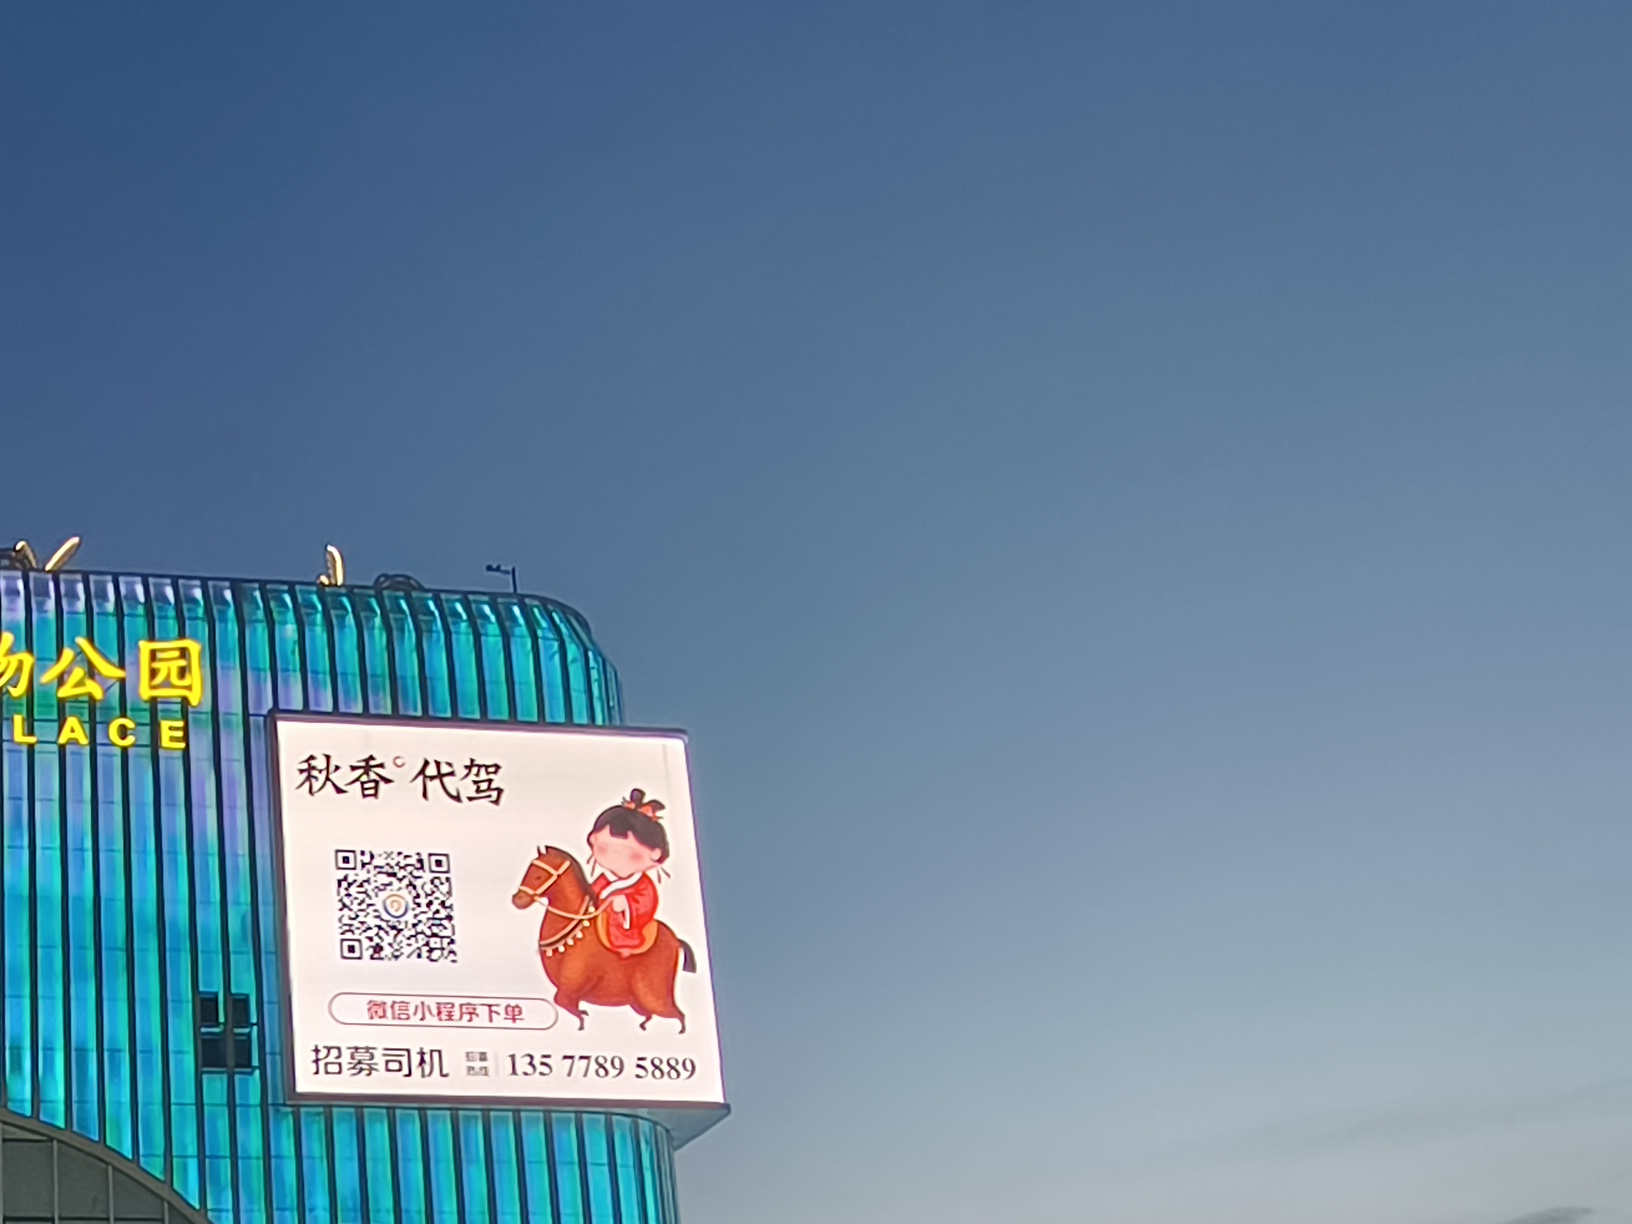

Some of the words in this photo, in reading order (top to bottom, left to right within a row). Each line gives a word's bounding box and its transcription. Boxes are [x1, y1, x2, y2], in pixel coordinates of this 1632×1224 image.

[366, 1000, 526, 1024] 微信小程序下单
[310, 1045, 450, 1078] 招募司机
[507, 1053, 553, 1078] 135
[562, 1053, 625, 1079] 7789
[635, 1055, 697, 1081] 5889
